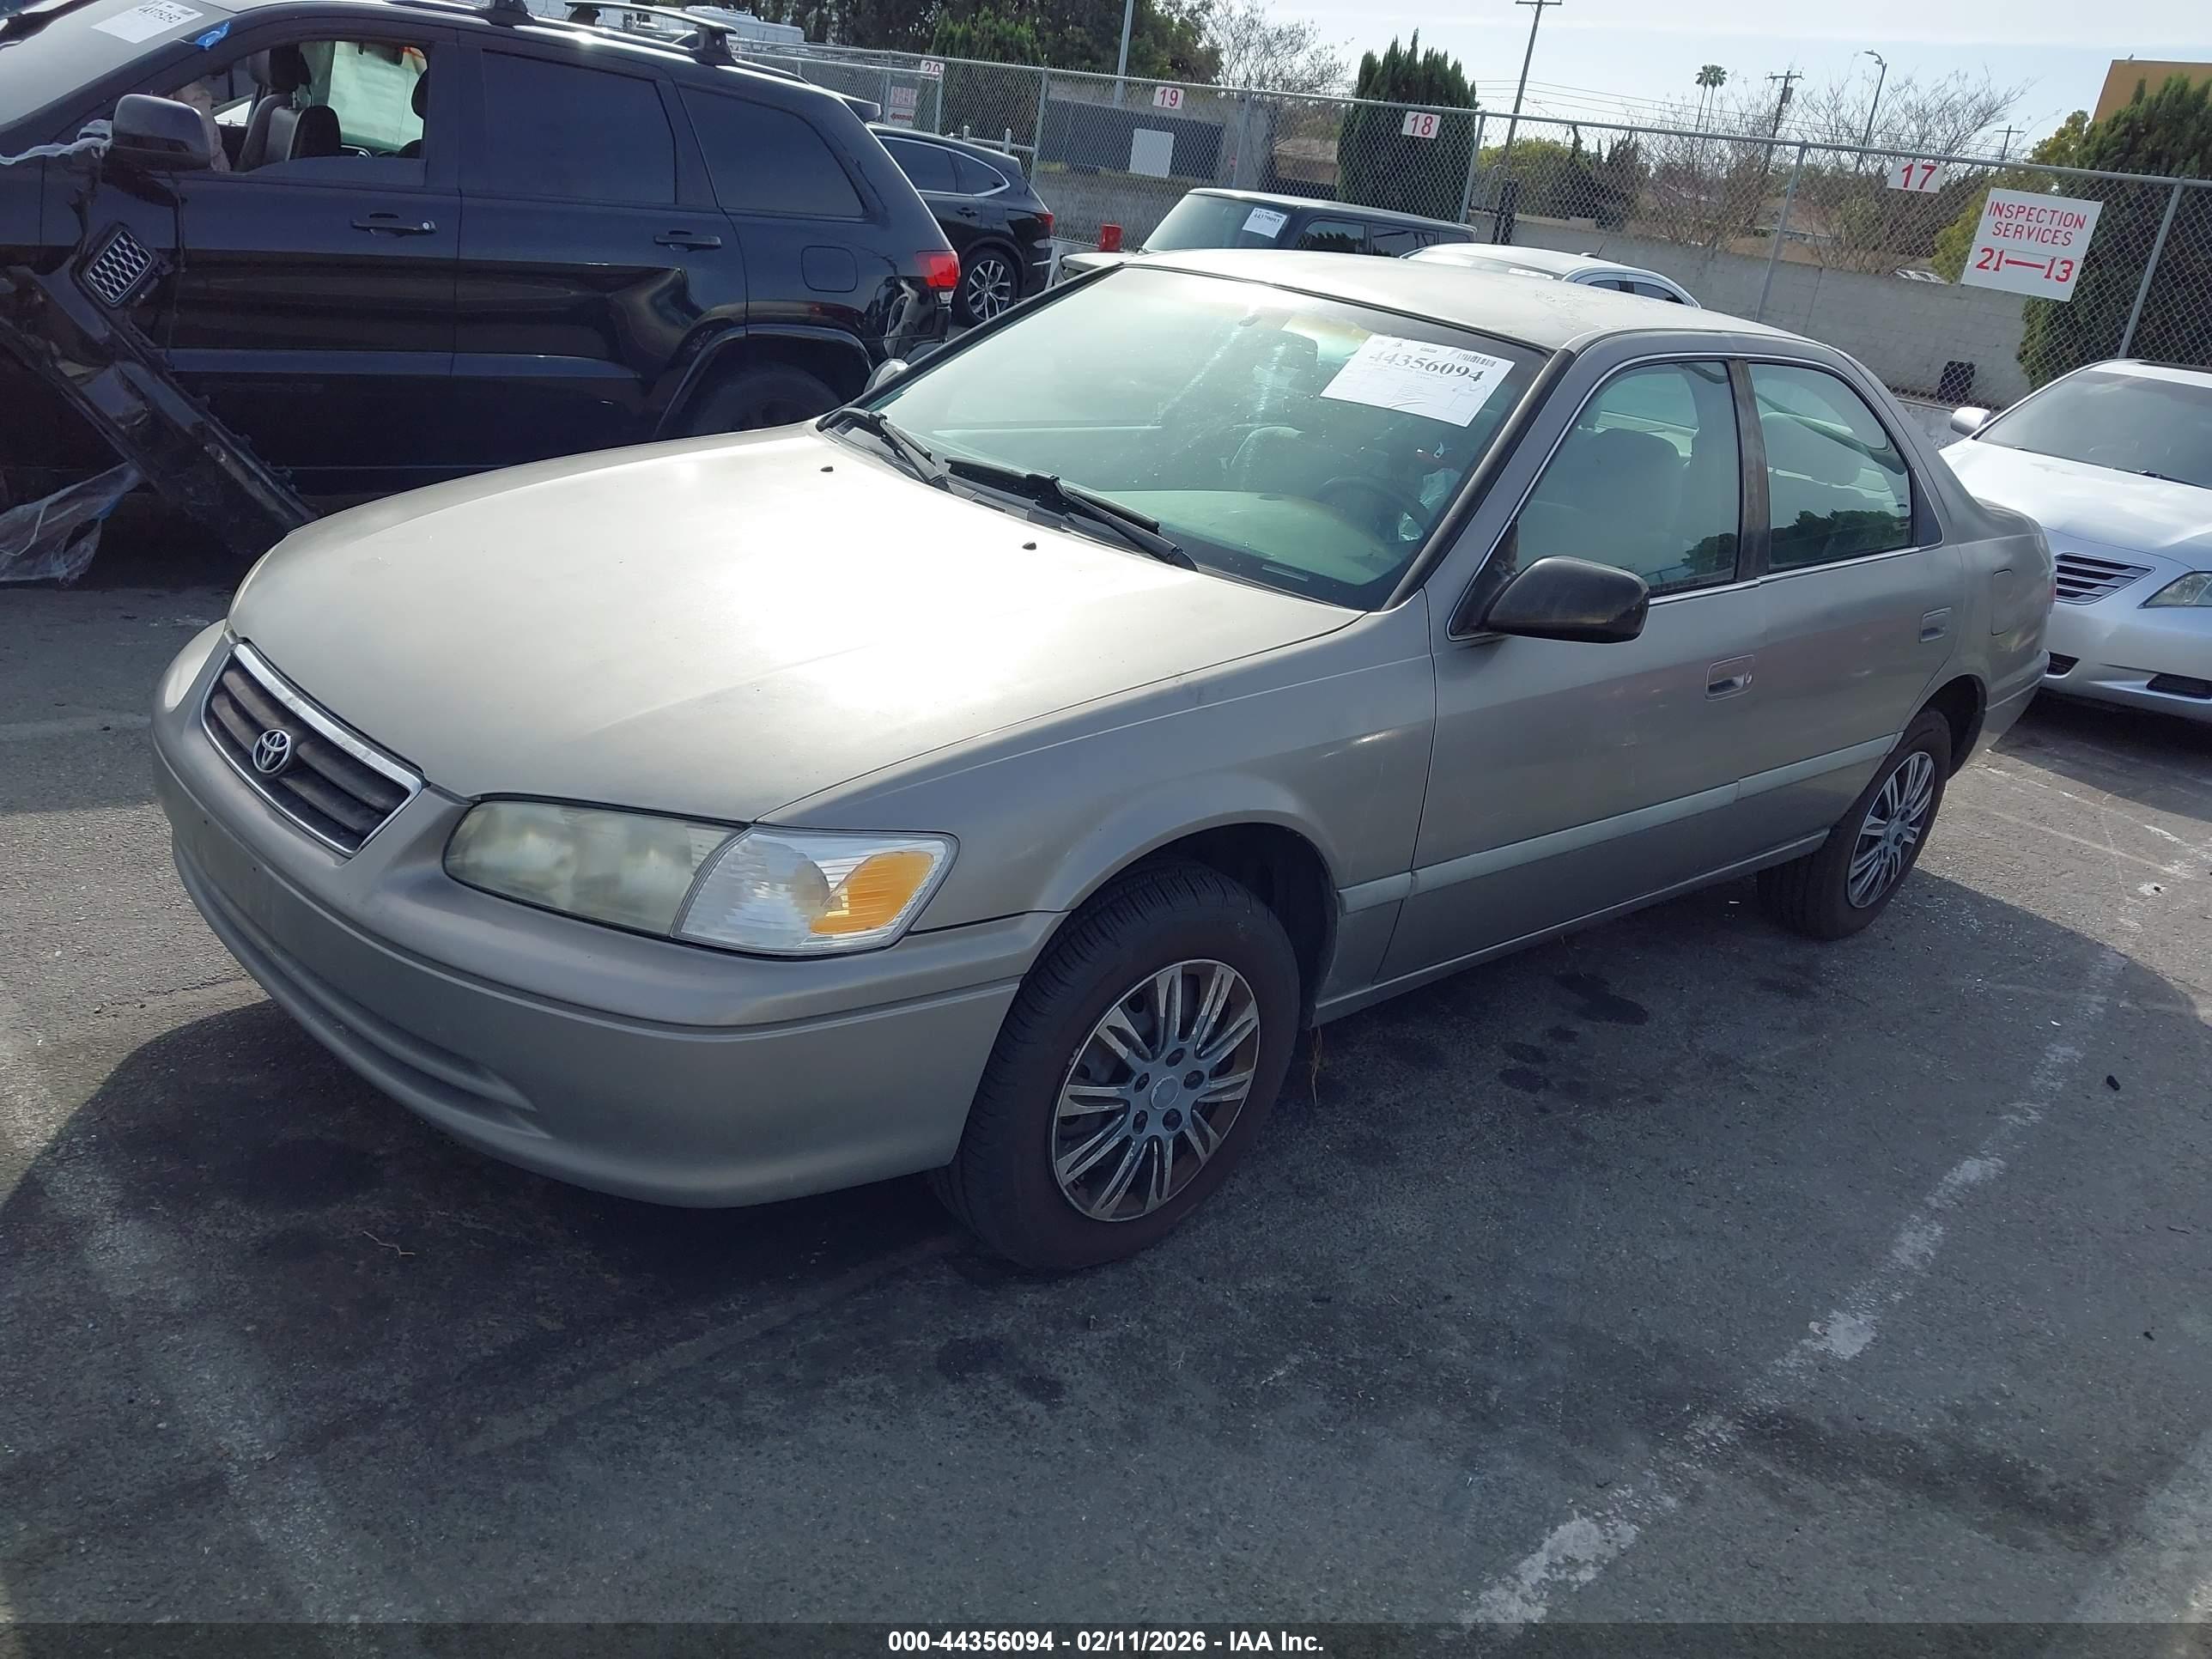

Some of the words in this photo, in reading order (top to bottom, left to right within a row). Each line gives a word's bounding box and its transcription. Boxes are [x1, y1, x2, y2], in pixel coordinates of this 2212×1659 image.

[1160, 88, 1179, 107] 19
[1411, 114, 1433, 136] 18
[1901, 162, 1937, 190] 17
[1988, 201, 2087, 230] INSPECTION
[1992, 221, 2074, 247] SERVICES
[1976, 247, 2005, 272] 21
[2044, 257, 2075, 283] 13
[1368, 350, 1485, 382] 44356094
